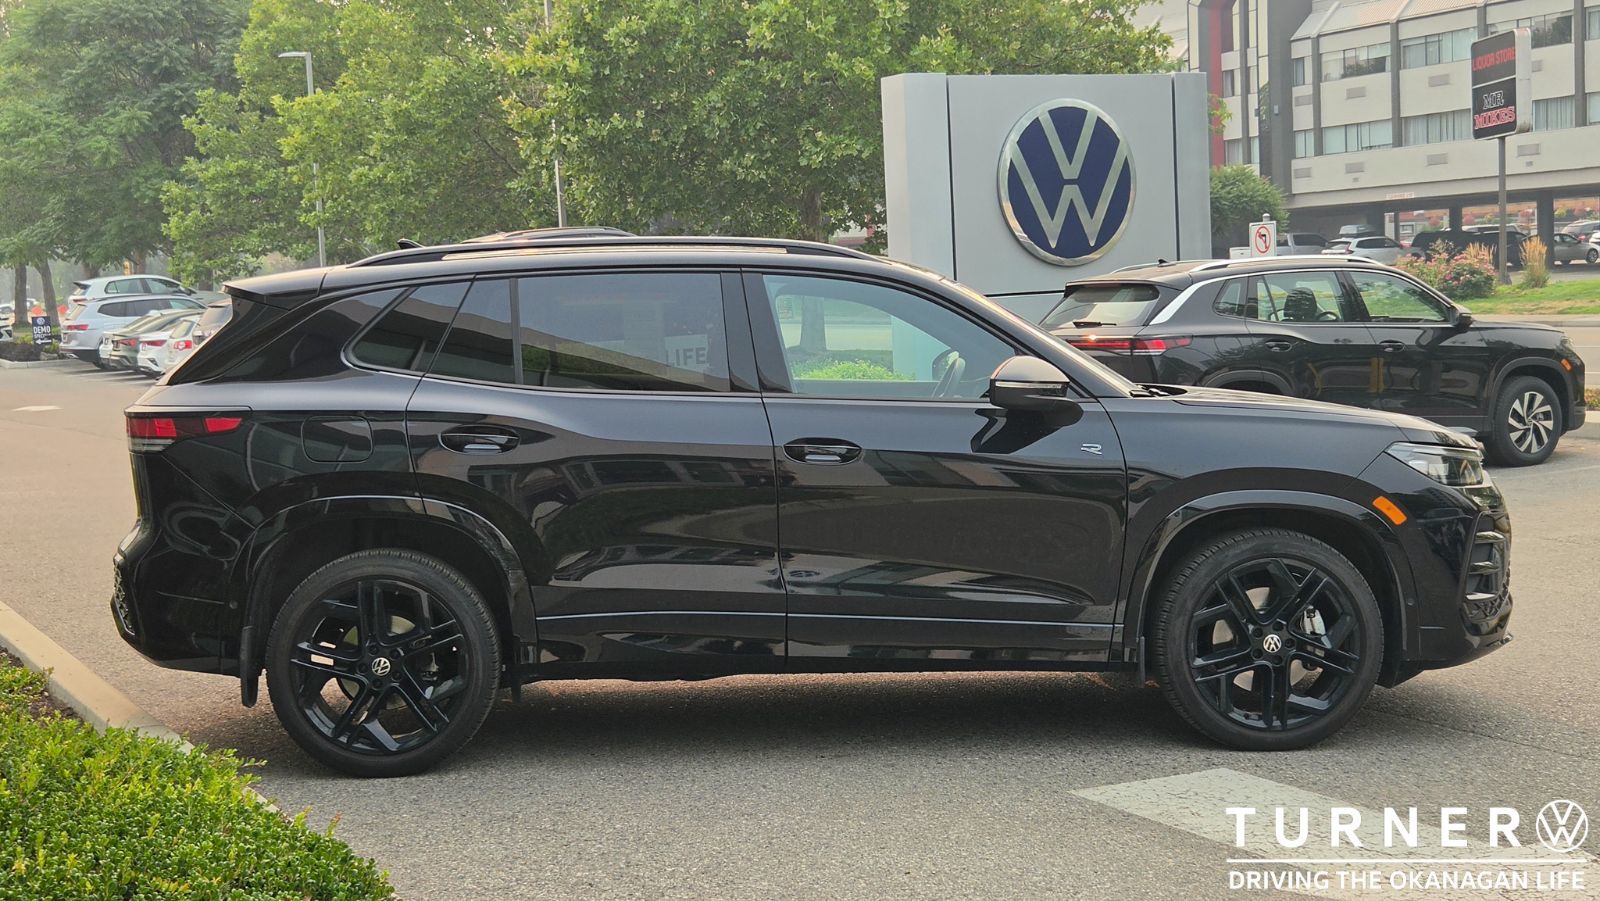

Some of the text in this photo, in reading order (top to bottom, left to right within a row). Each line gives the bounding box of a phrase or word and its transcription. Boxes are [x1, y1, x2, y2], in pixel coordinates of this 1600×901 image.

[1473, 53, 1495, 70] LIQUOR
[1483, 90, 1504, 109] MR
[1474, 106, 1516, 129] MIKES
[33, 325, 51, 334] DEMO
